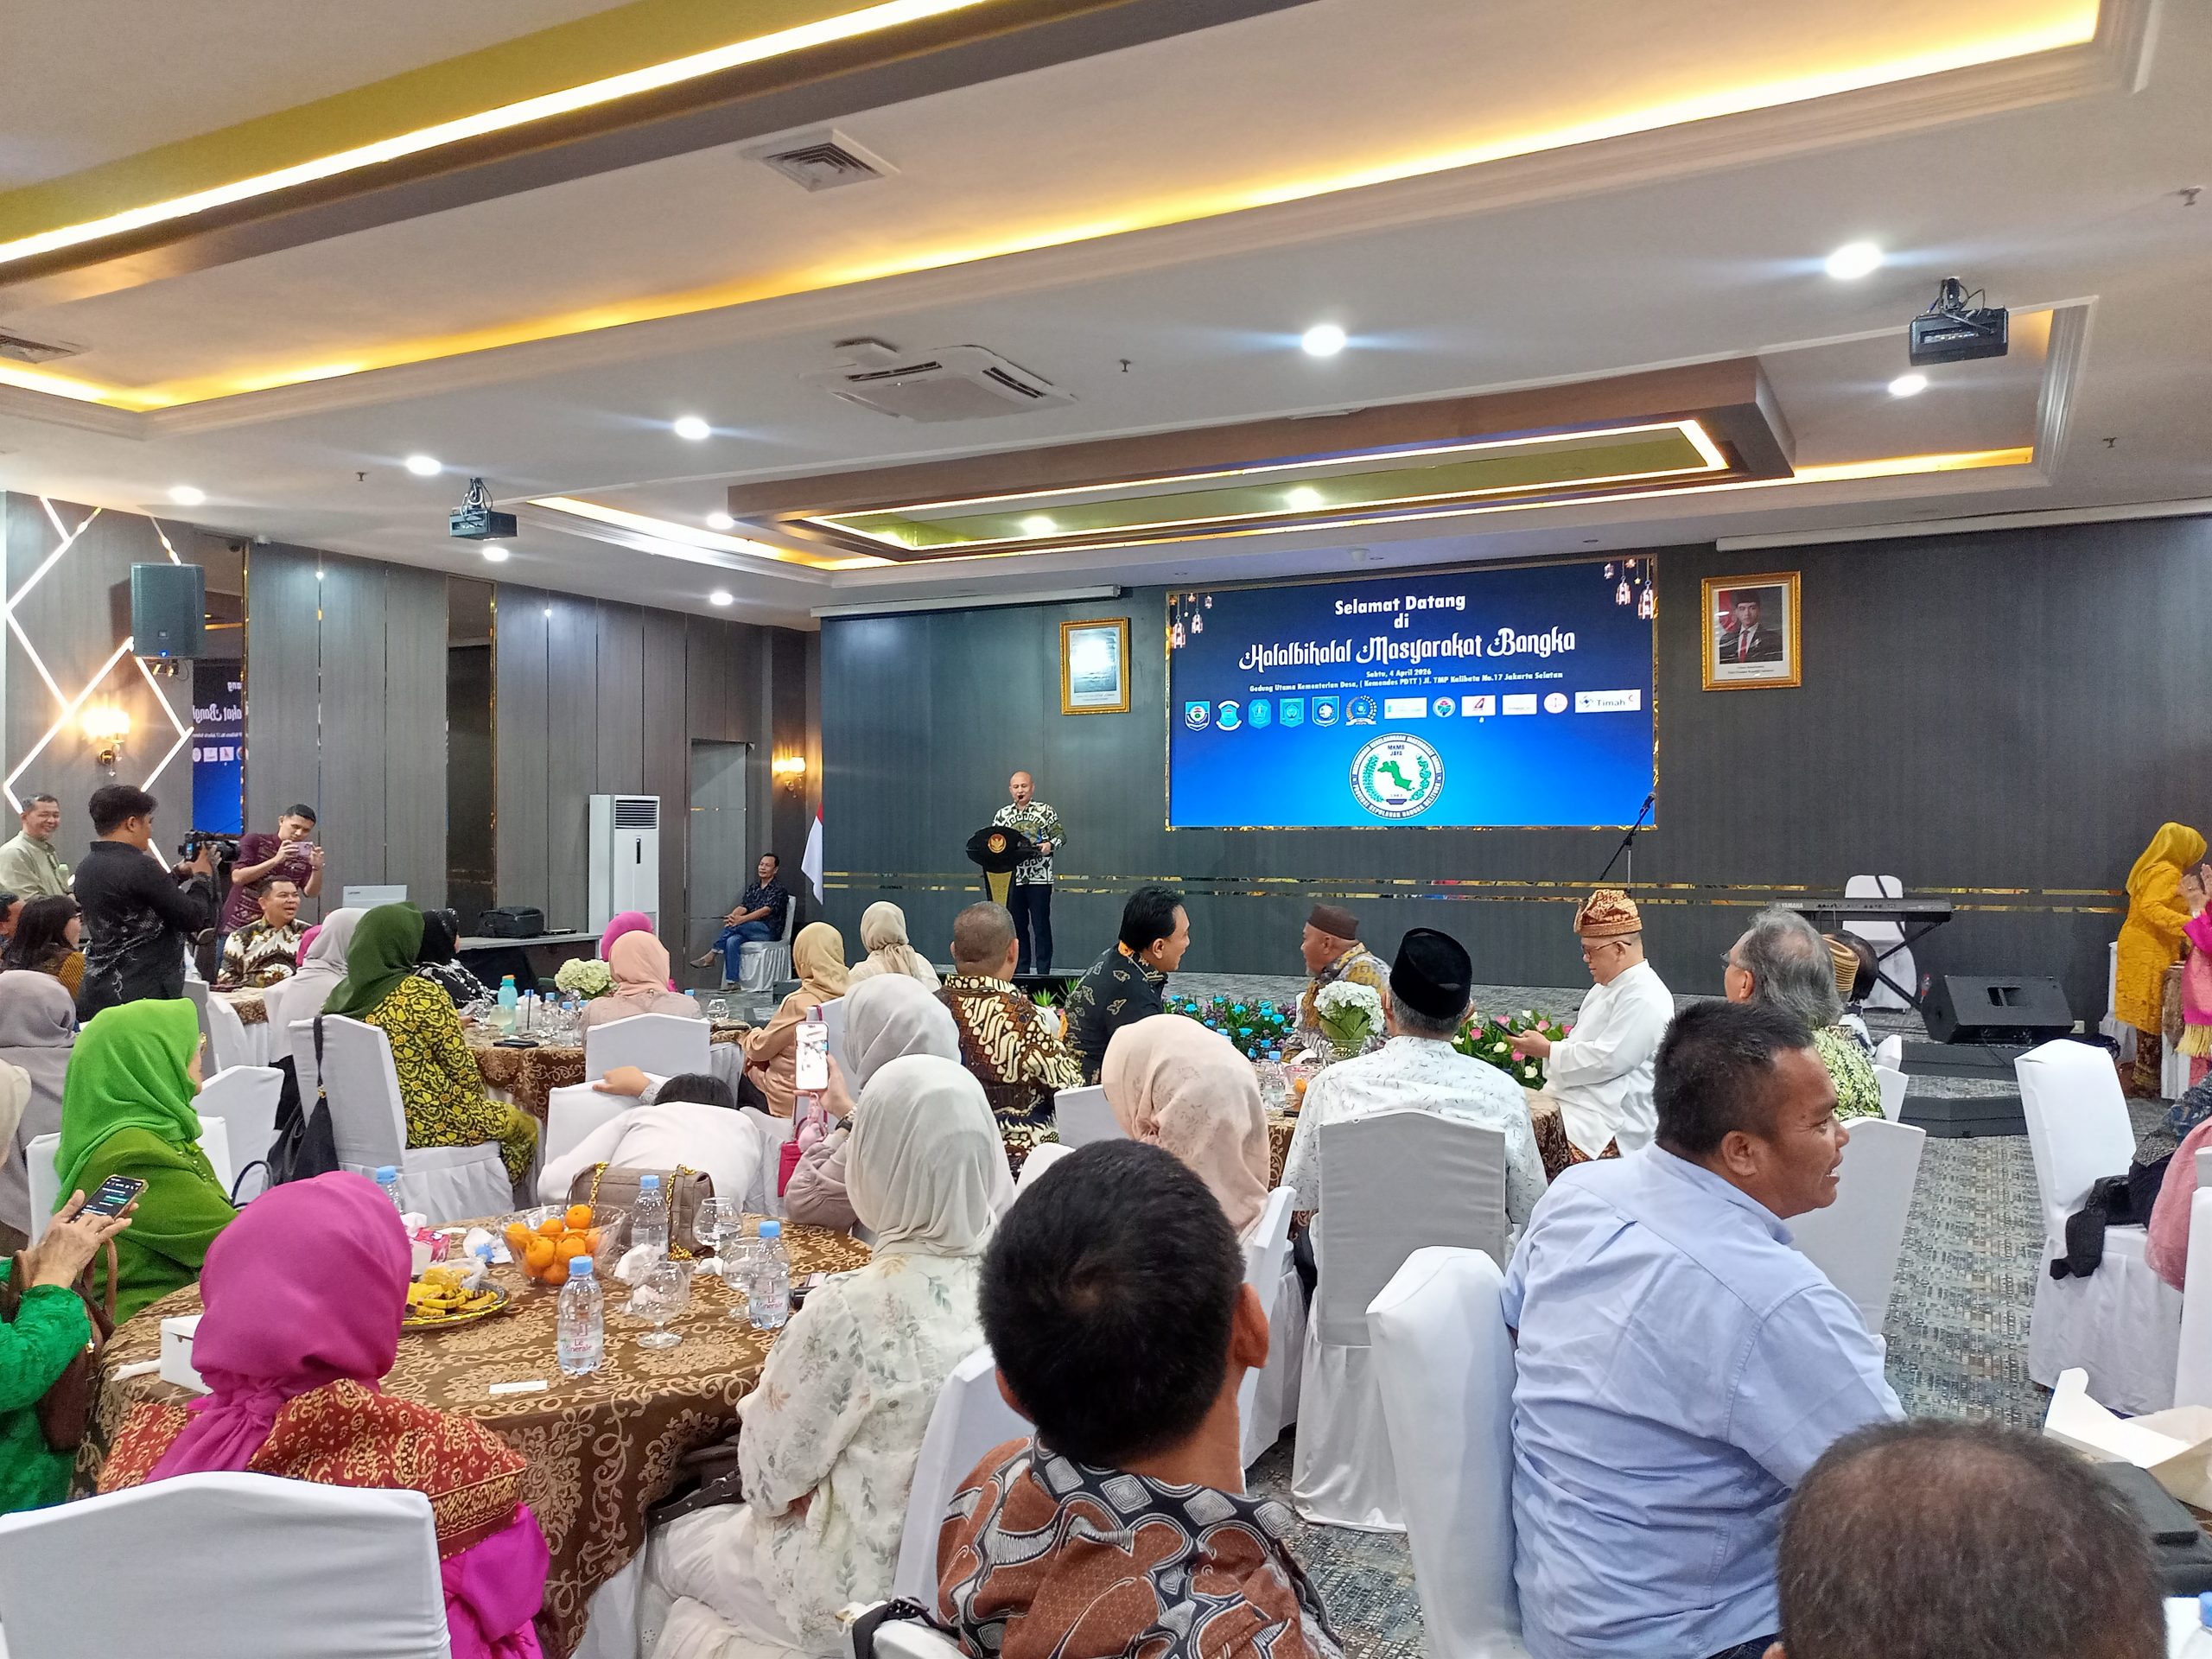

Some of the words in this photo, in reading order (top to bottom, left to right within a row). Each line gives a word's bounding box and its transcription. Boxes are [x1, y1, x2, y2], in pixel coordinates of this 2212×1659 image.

[1334, 597, 1401, 616] Selamat
[1405, 595, 1466, 611] Datang
[1393, 613, 1409, 629] di
[1238, 639, 1352, 673] Halalbihalal
[1355, 632, 1483, 664] Masyarakat
[1486, 626, 1575, 658] Bangka
[1395, 669, 1413, 678] April
[1249, 684, 1274, 693] Gedung
[1297, 682, 1338, 690] Kementerian
[1450, 675, 1480, 683] Kalibata
[1481, 673, 1503, 682] No.17
[1597, 698, 1626, 707] Timah
